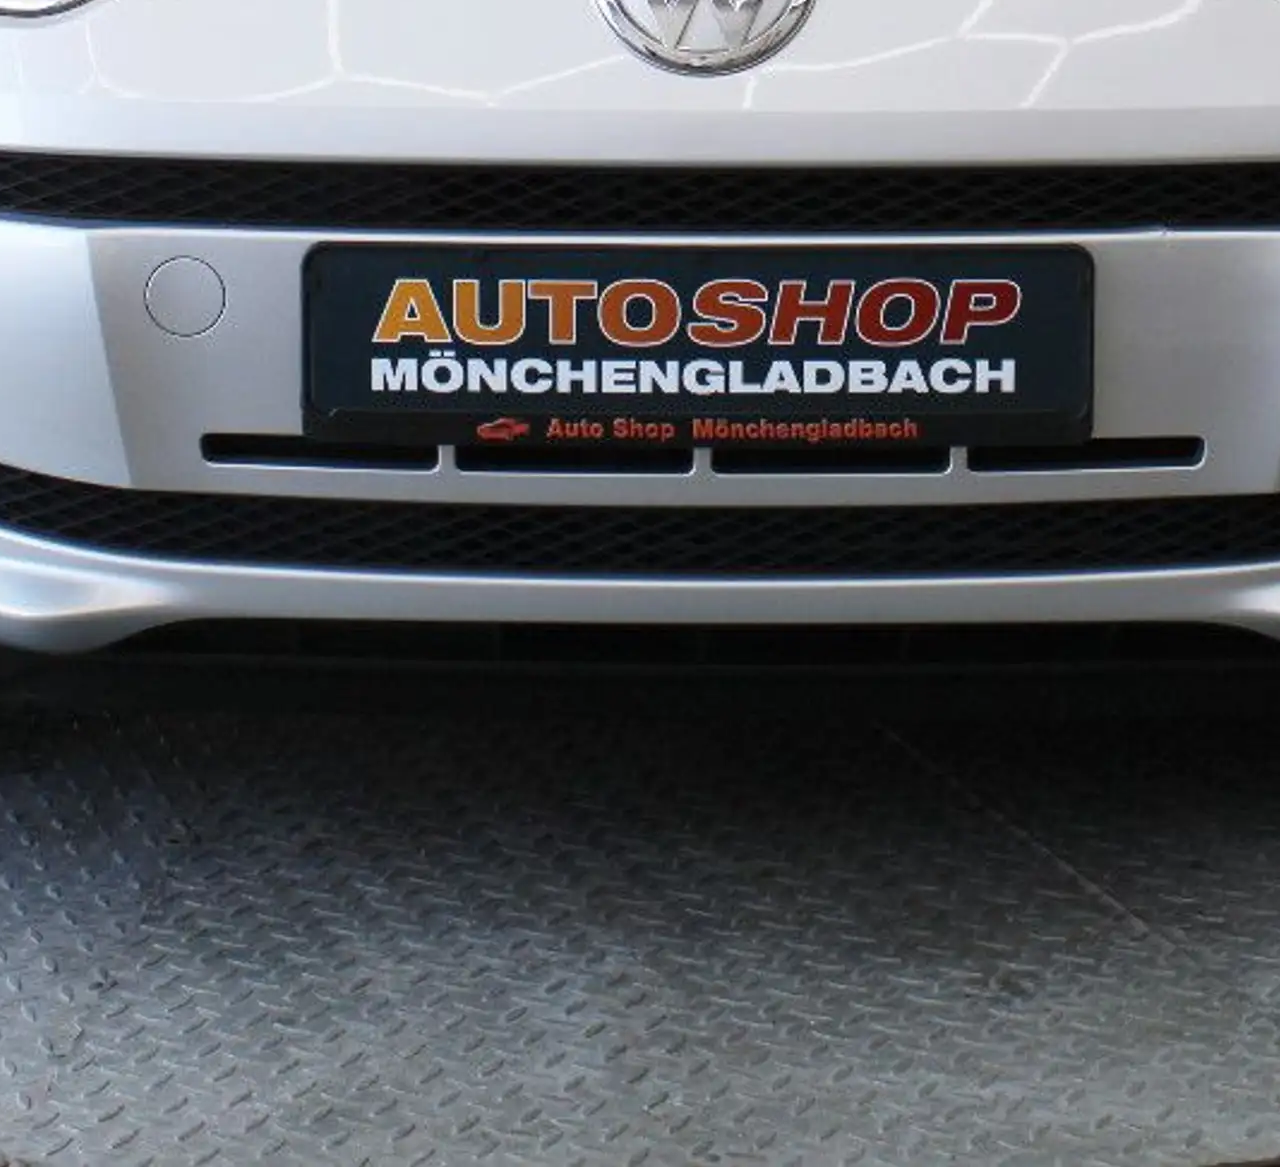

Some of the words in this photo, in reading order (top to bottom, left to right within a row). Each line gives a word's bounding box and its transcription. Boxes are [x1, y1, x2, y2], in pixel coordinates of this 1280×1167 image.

[371, 277, 1023, 347] AUTOSHOP
[370, 351, 1017, 396] MÖNCHENGLADBACH
[546, 417, 604, 440] Auto
[613, 417, 676, 444] Shop
[692, 417, 919, 444] Mönchengladbach
